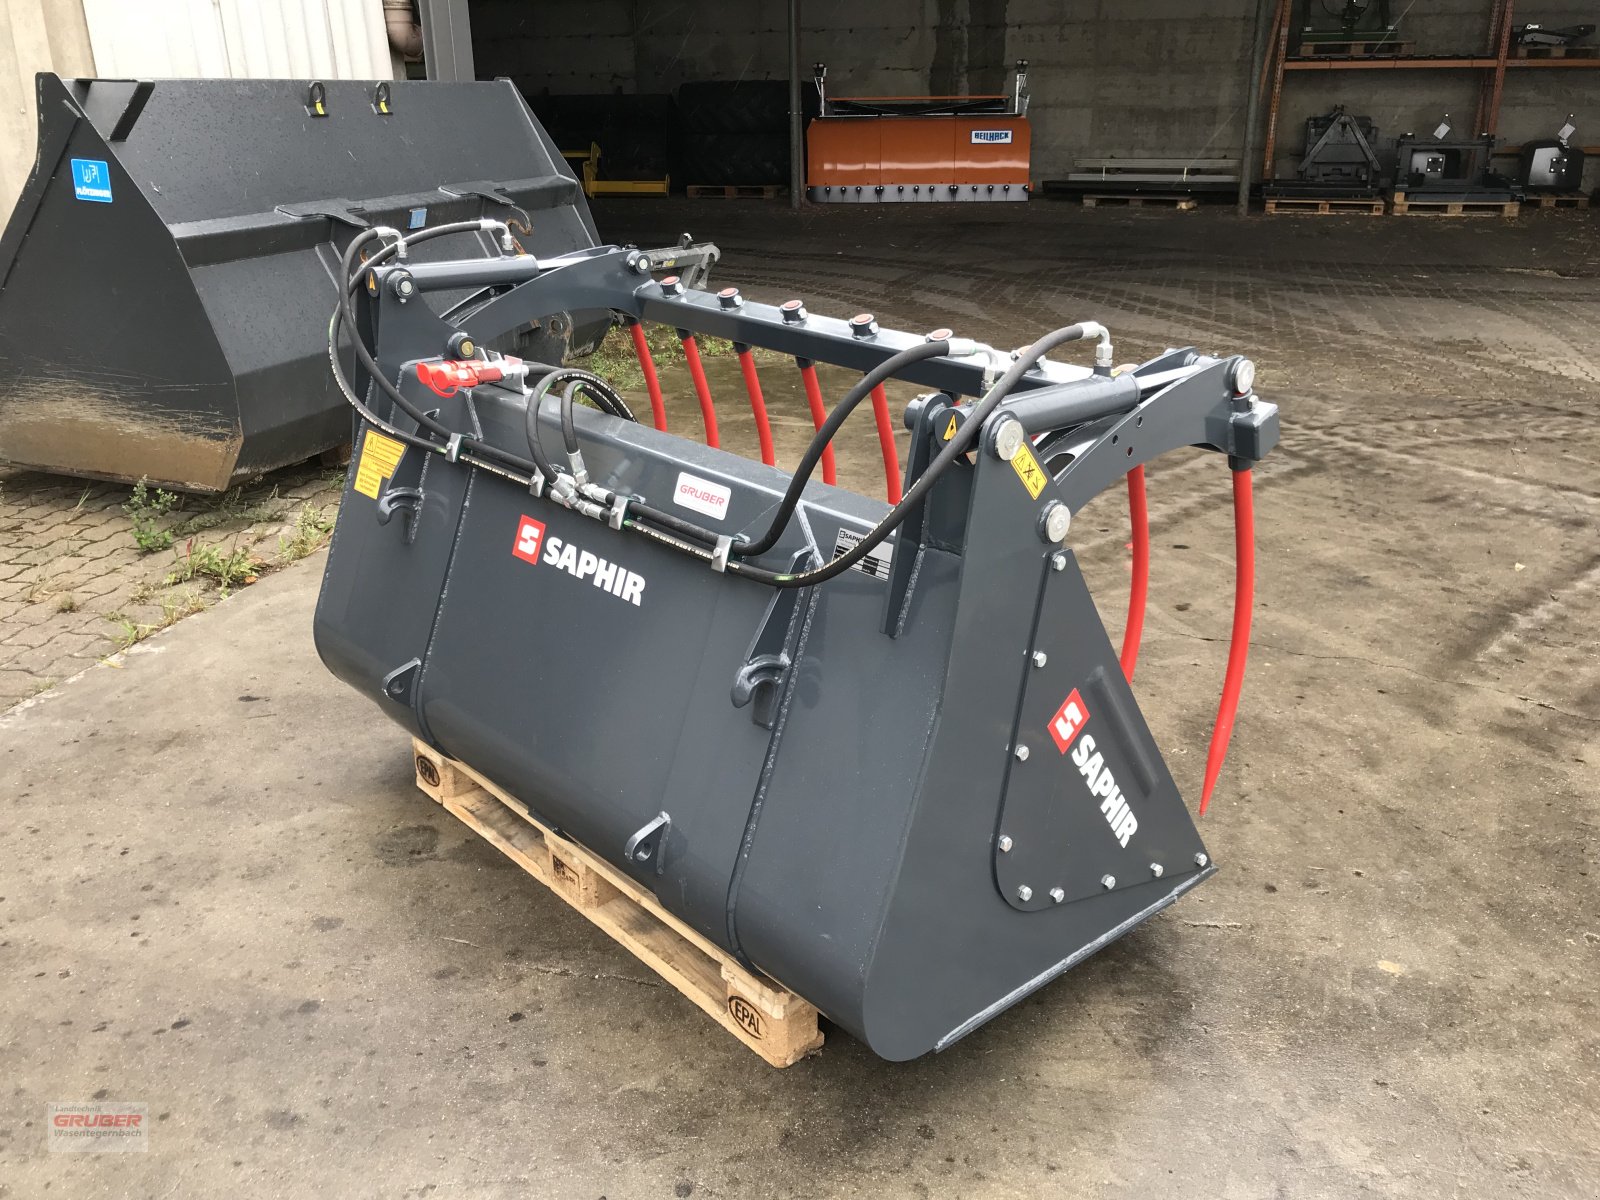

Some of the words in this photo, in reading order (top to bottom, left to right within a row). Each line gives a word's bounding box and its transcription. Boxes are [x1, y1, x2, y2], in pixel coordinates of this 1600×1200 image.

[974, 132, 1009, 142] BEILHACK
[680, 484, 725, 507] GRUBER
[542, 536, 646, 606] SAPHIR
[1071, 734, 1138, 849] SAPHIR
[735, 1001, 761, 1036] EPAL
